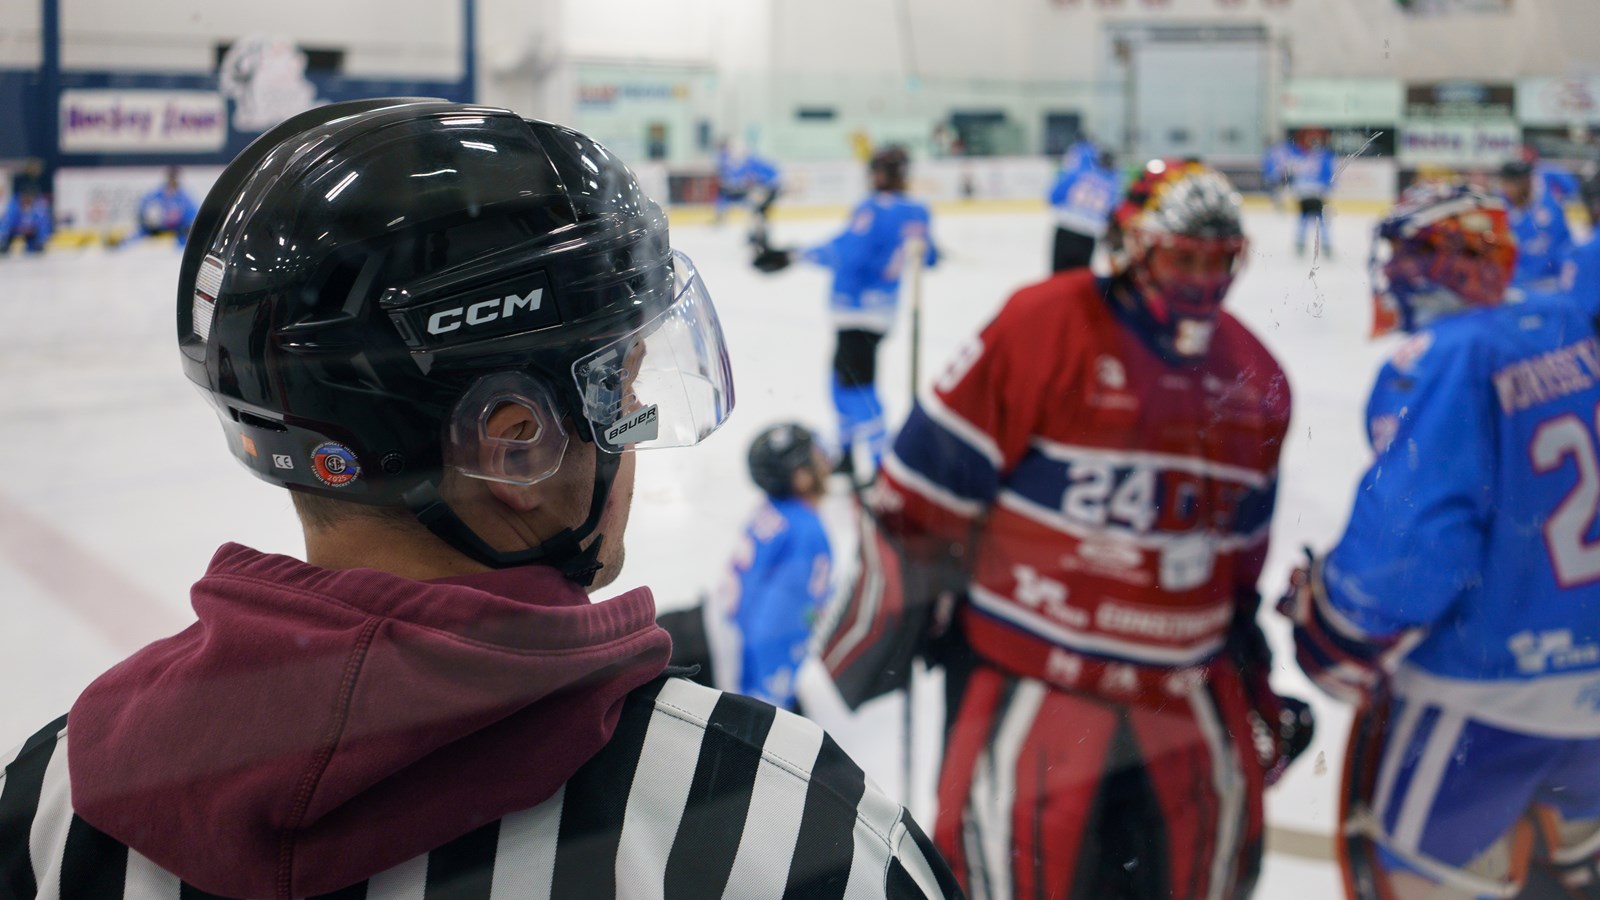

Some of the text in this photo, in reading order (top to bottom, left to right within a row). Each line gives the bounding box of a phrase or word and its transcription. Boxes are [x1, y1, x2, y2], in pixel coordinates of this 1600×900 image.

[427, 288, 543, 335] CCM
[275, 455, 292, 468] CE
[327, 474, 347, 483] 2025
[1061, 458, 1157, 534] 24
